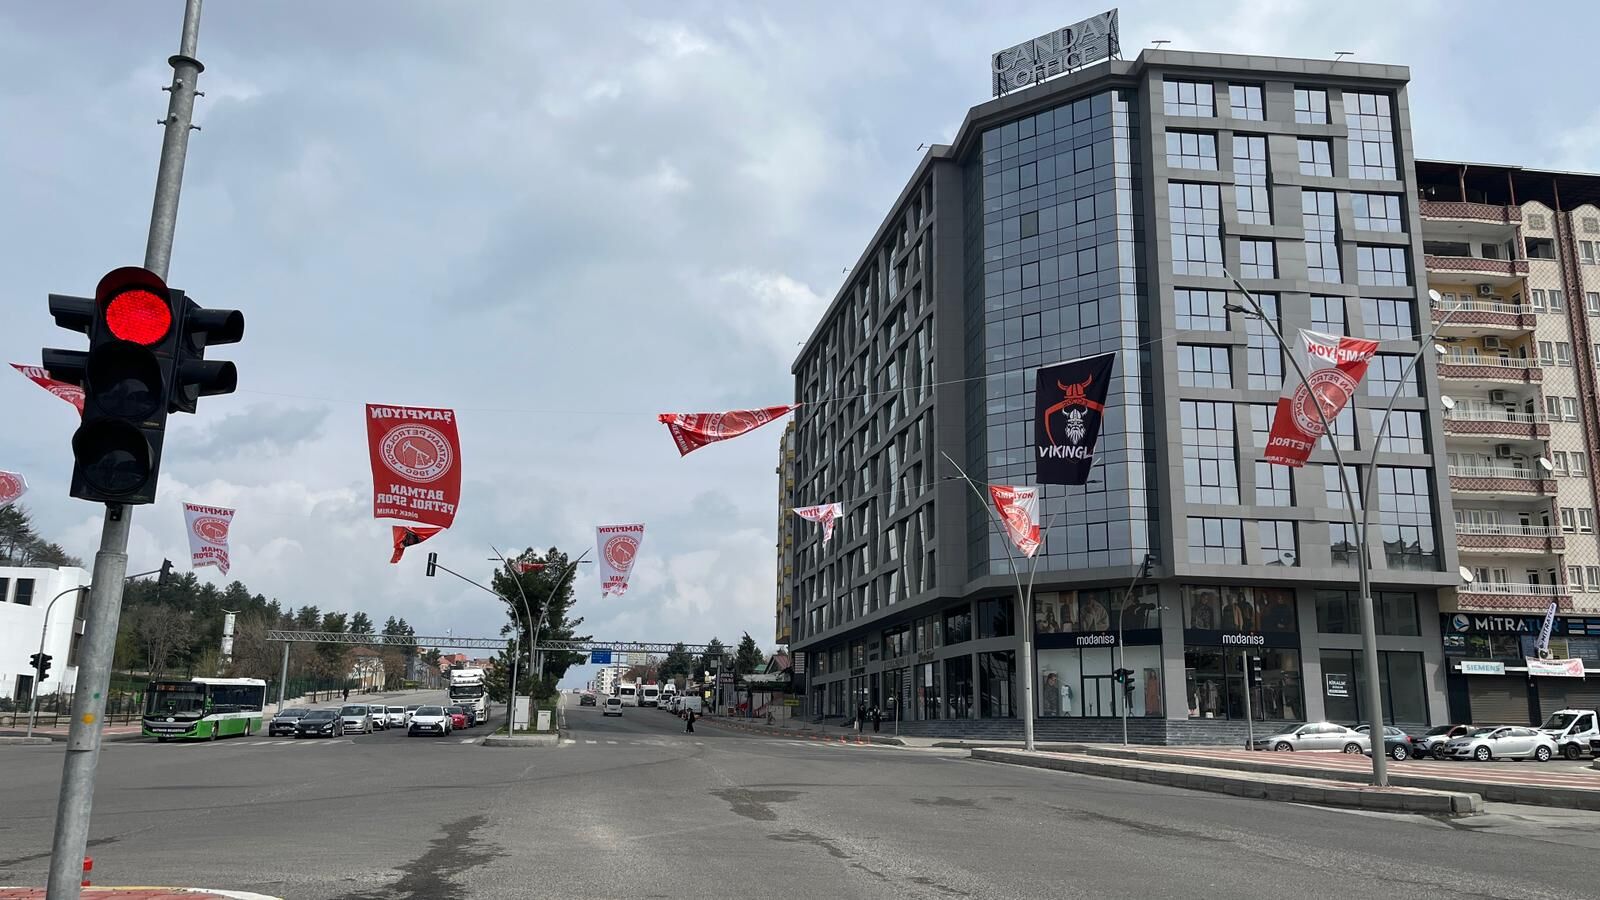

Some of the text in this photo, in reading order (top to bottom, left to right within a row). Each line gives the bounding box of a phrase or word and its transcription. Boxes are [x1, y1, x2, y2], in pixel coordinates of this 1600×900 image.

[992, 9, 1118, 73] CANDAY
[1013, 46, 1097, 86] OFFICE
[1076, 632, 1115, 646] modanisa
[1222, 632, 1265, 645] modanisa
